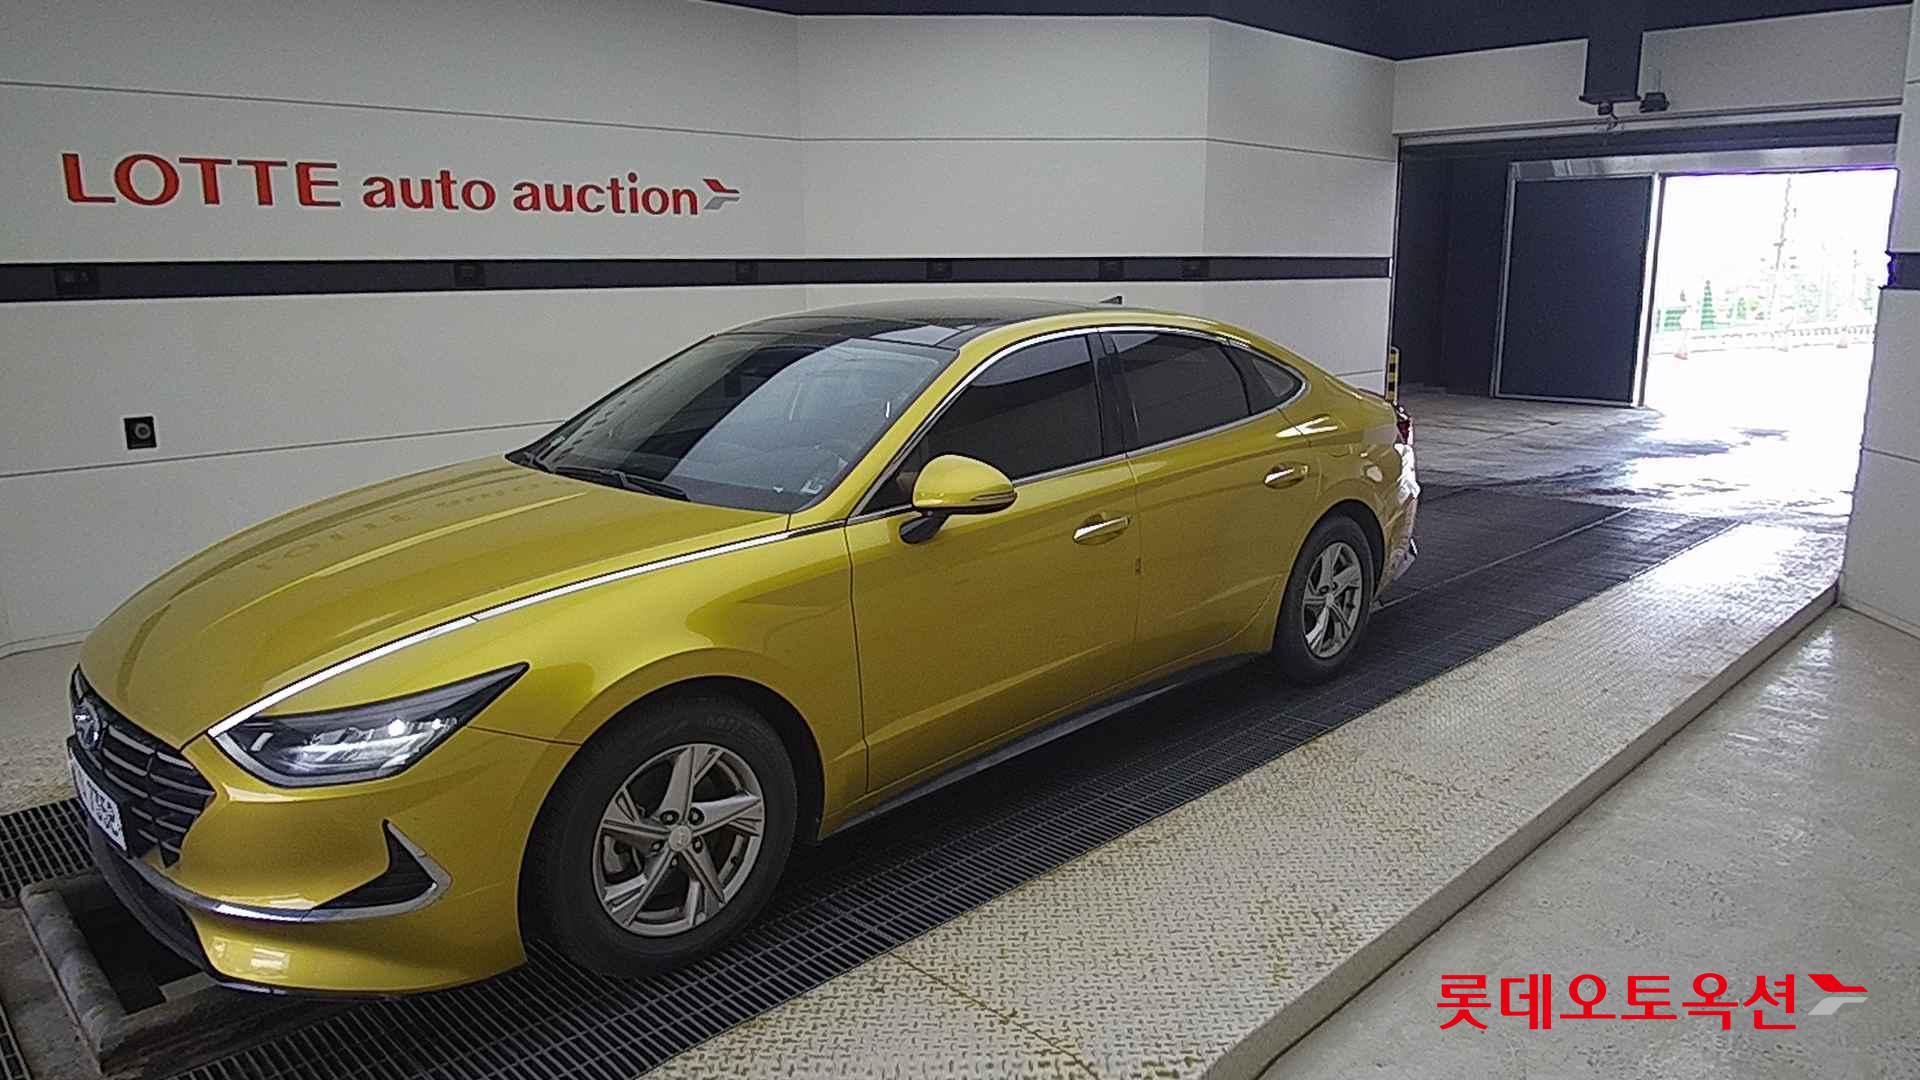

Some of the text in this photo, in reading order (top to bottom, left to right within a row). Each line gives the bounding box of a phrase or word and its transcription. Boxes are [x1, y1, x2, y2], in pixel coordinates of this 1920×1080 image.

[61, 153, 700, 216] LOTTE auto auction
